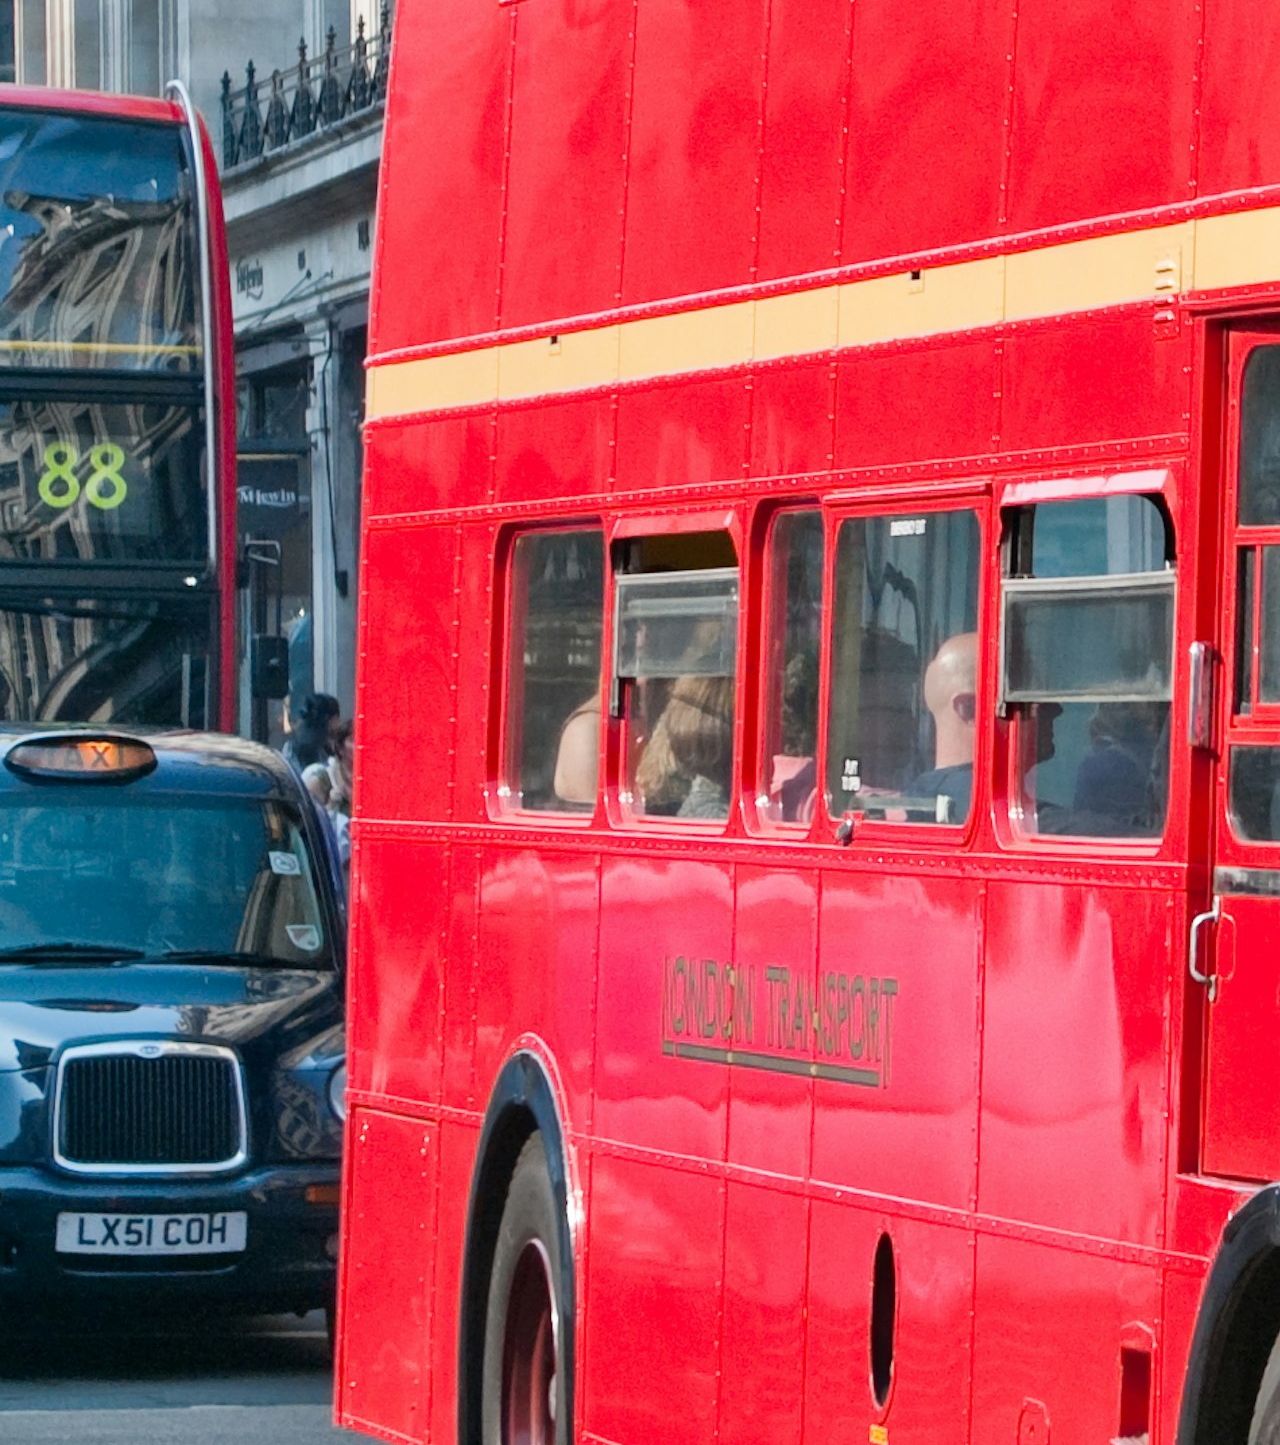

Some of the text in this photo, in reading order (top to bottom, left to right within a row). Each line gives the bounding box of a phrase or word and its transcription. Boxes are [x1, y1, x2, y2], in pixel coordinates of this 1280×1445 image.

[38, 441, 128, 509] 88
[661, 955, 898, 1087] LONDON TRANSPORT
[77, 1215, 227, 1247] LX51 COH
